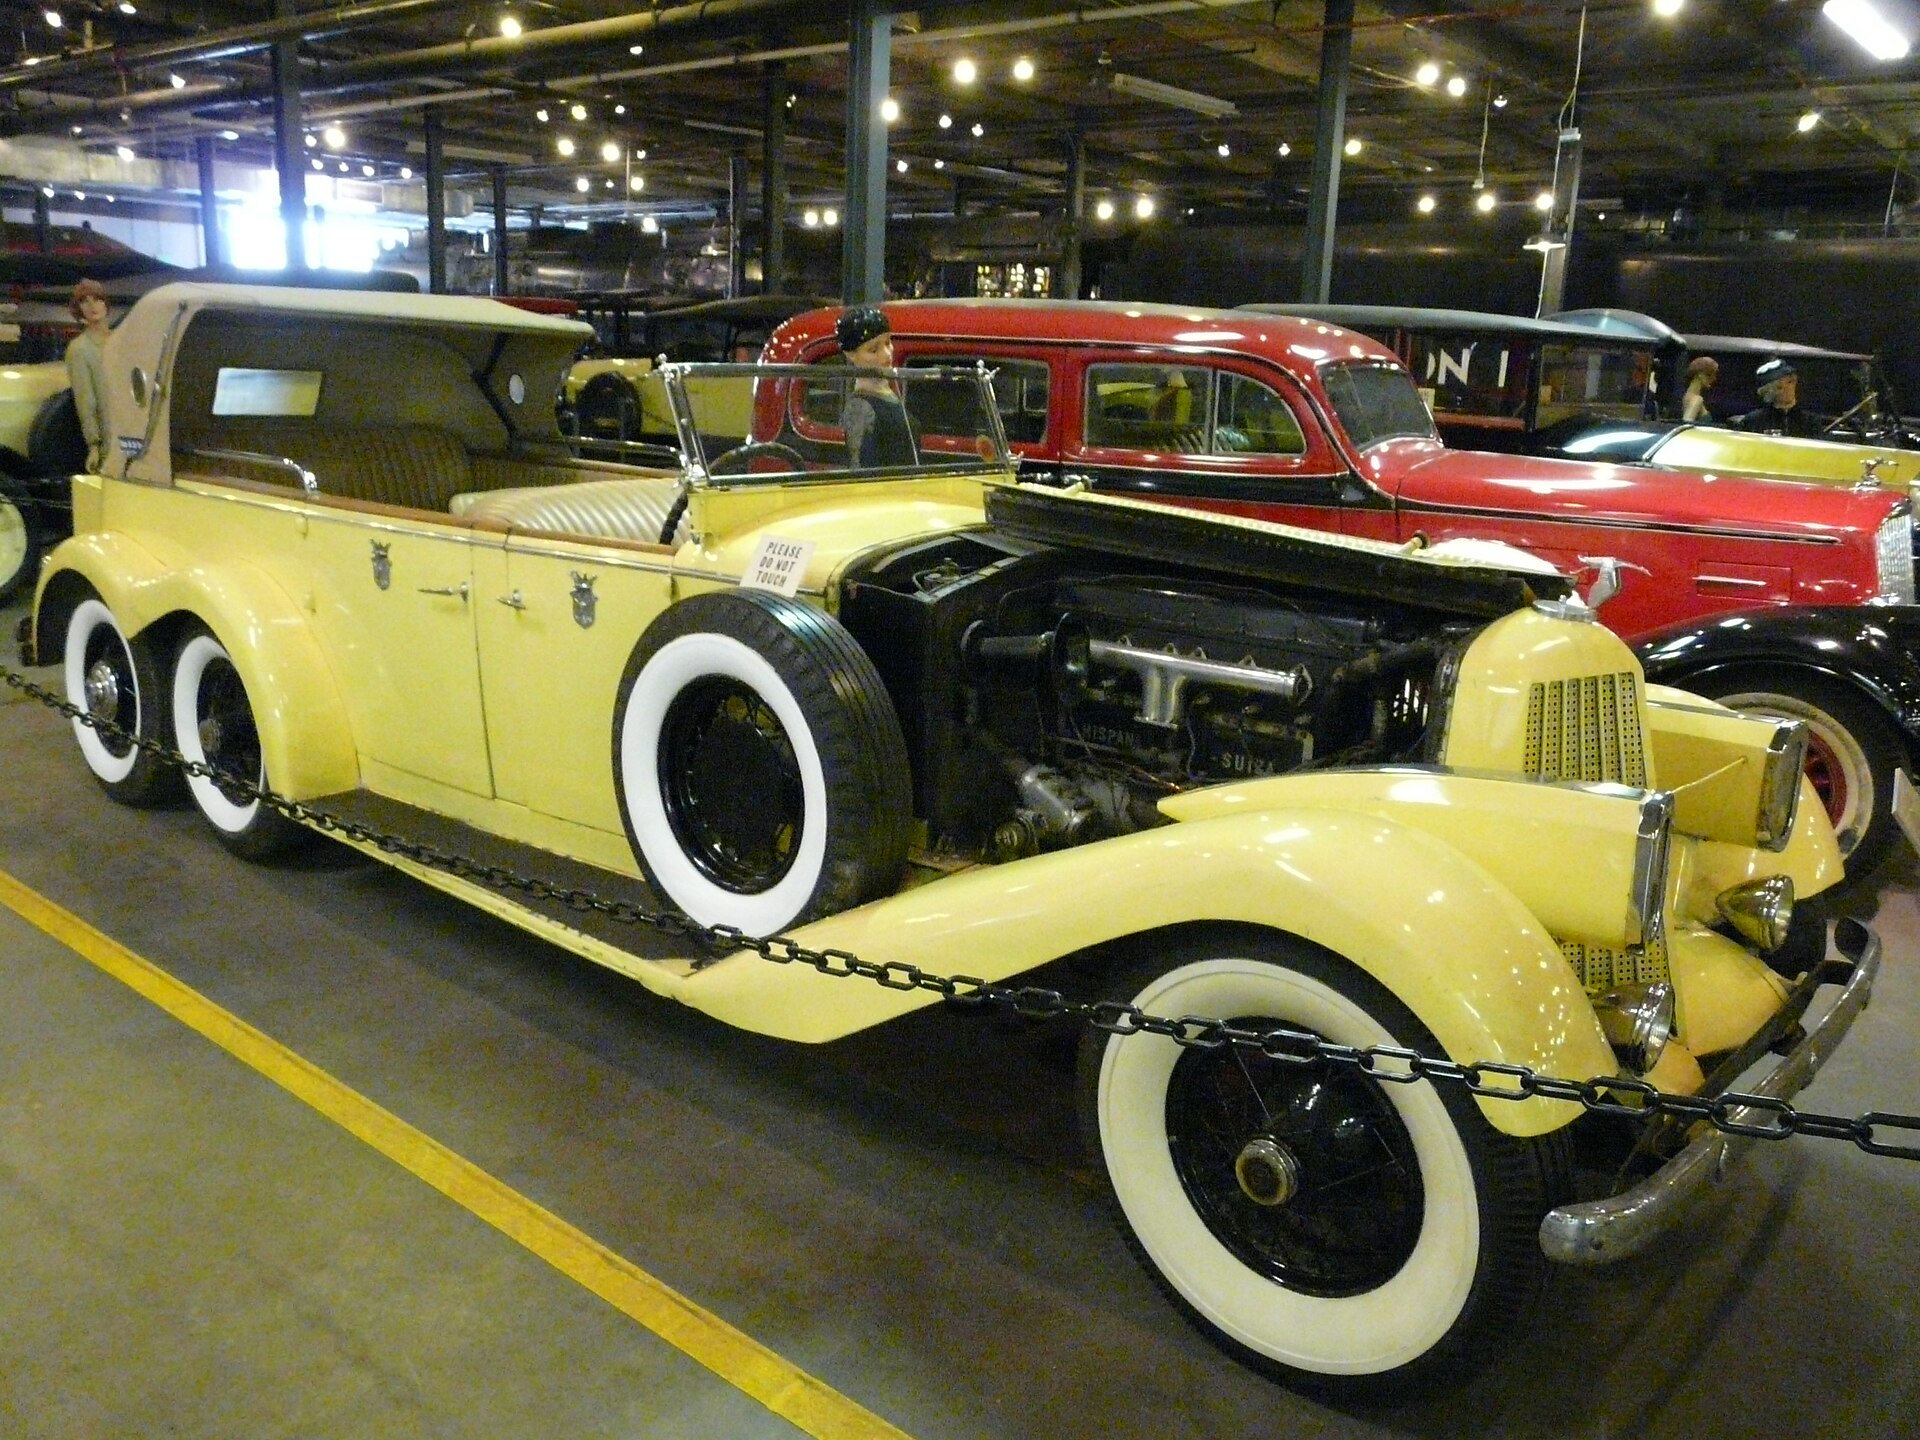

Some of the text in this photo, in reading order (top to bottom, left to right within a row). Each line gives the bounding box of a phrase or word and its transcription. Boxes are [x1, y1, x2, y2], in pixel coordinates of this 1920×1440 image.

[766, 541, 803, 559] PLEASE
[759, 556, 796, 573] DO NOT
[755, 570, 787, 588] TOUCH
